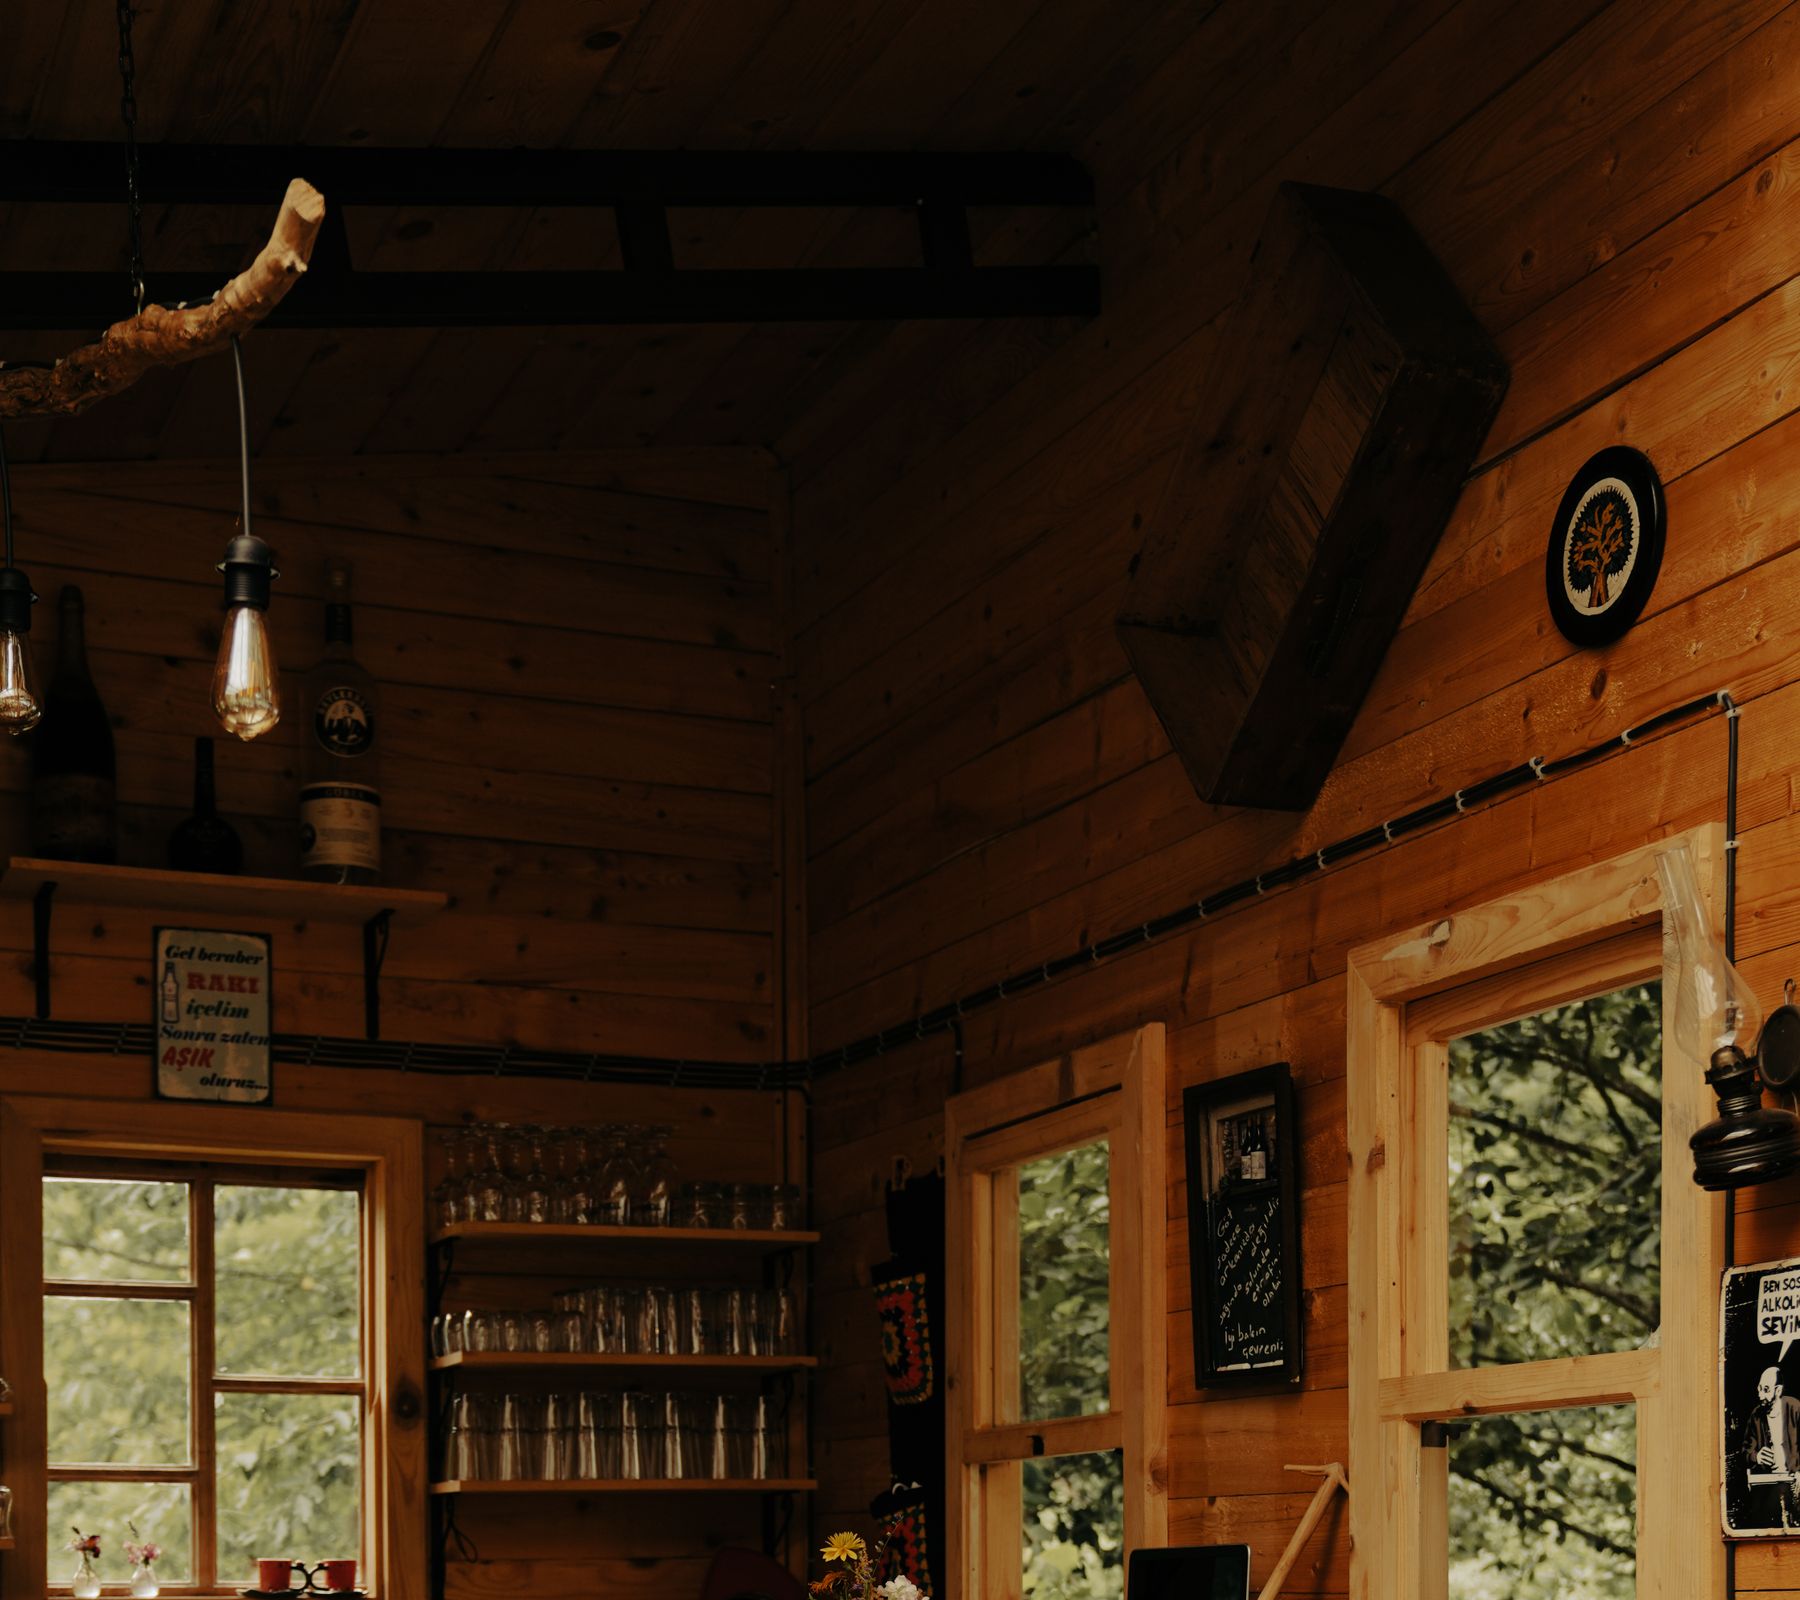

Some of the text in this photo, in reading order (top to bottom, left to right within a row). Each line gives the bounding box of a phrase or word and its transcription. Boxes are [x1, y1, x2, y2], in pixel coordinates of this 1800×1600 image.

[165, 945, 264, 965] Gel beraber
[187, 972, 260, 994] RAKI
[187, 998, 249, 1020] içelim
[161, 1025, 270, 1046] Sonra zaten
[161, 1046, 215, 1072] AŞIK
[1763, 1280, 1780, 1294] BEN
